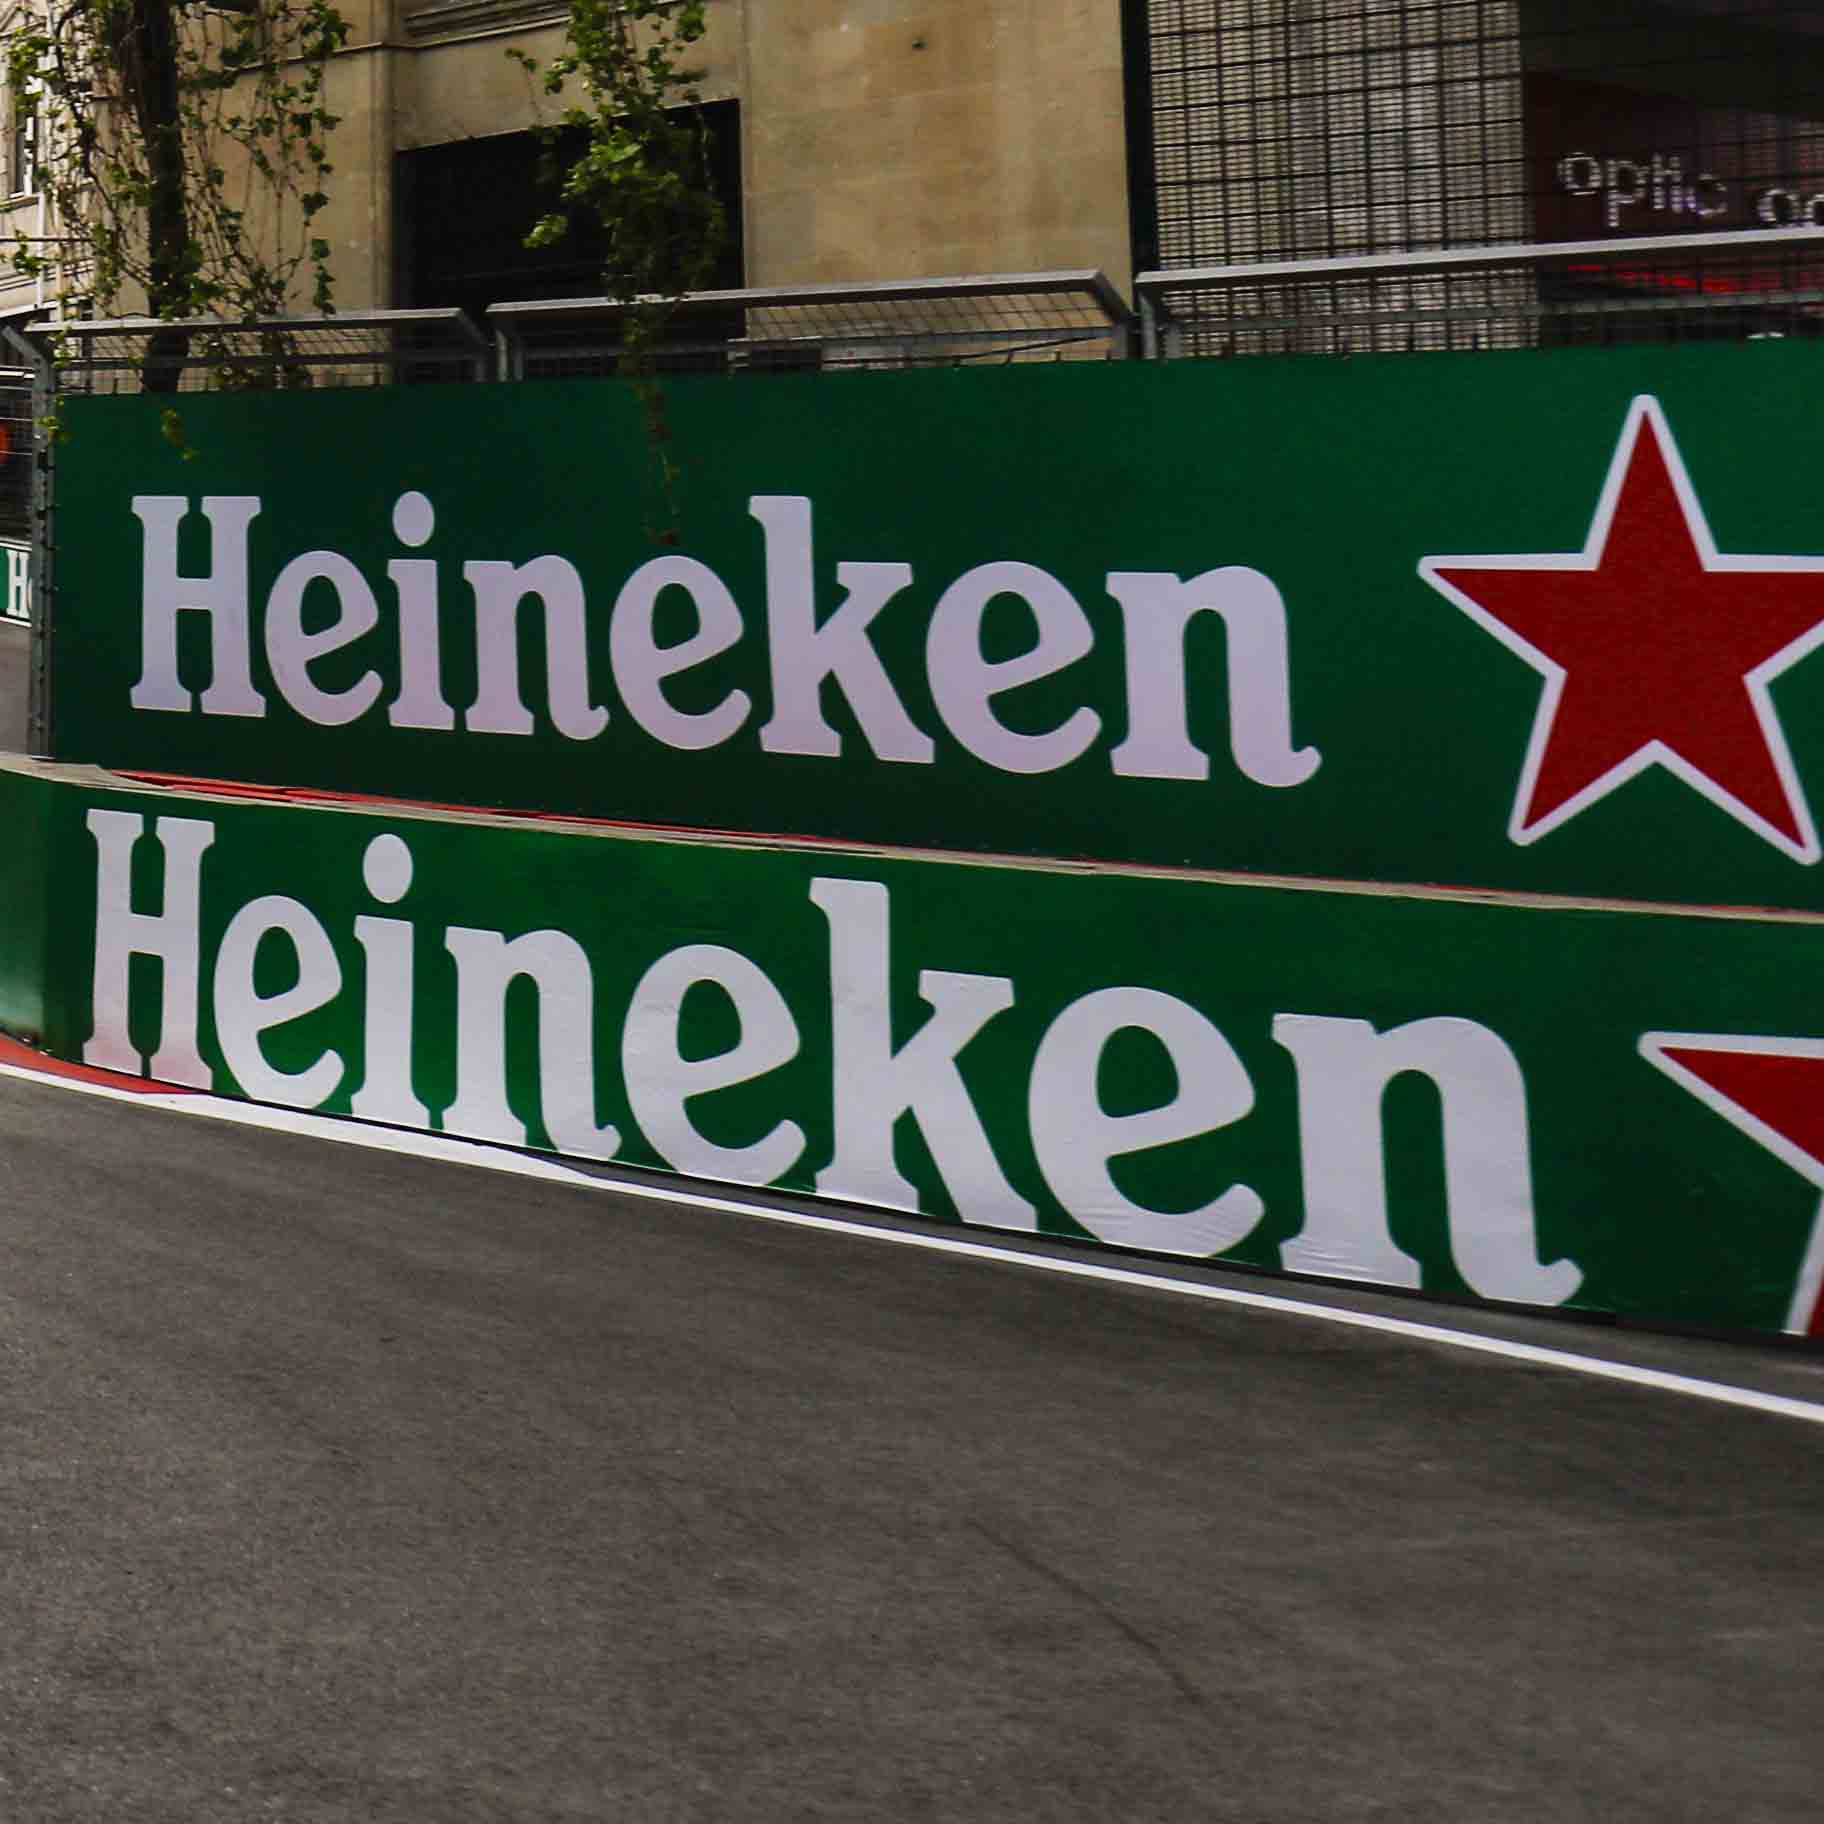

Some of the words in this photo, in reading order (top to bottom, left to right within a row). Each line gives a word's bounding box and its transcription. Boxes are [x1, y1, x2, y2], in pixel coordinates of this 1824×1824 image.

[6, 549, 32, 618] H
[130, 490, 1321, 787] Heineken
[83, 808, 1584, 1307] Heineken
